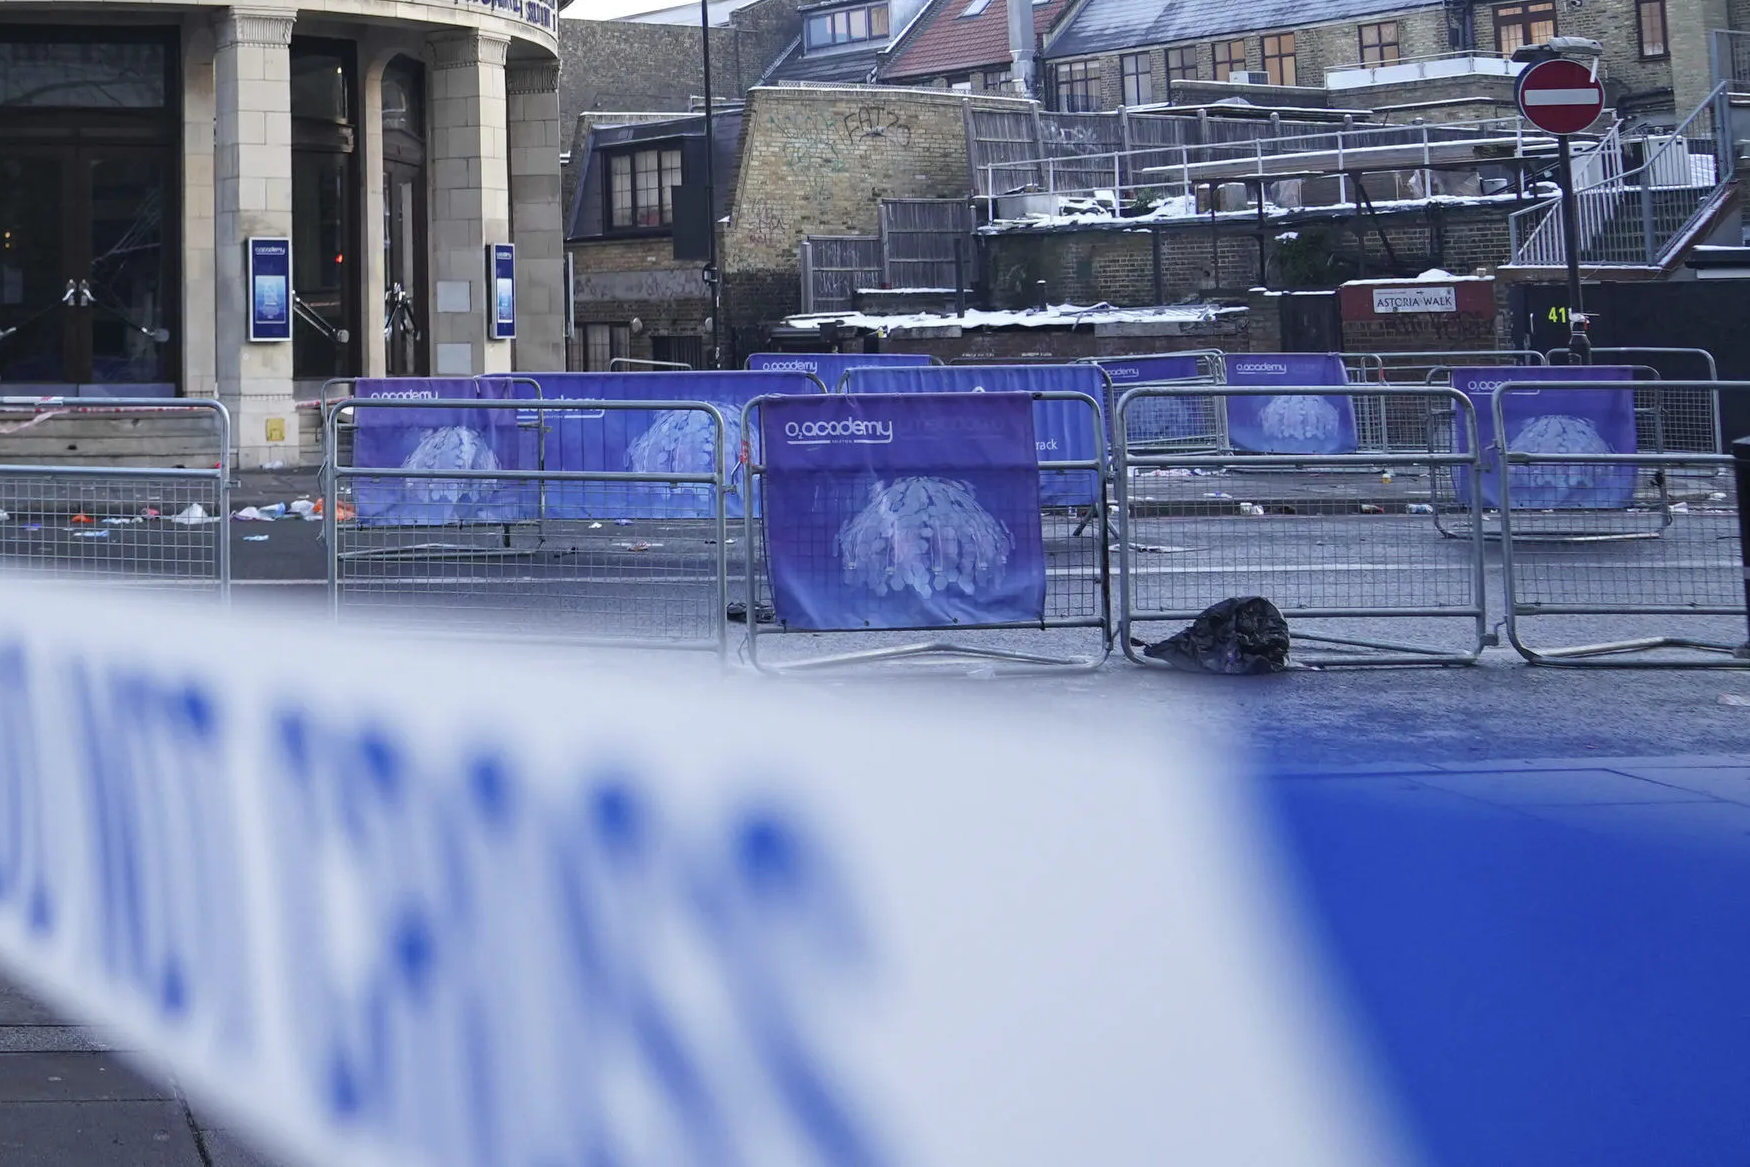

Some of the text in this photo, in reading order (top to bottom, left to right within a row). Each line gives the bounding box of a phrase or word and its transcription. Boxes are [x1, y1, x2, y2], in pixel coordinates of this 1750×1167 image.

[1377, 296, 1453, 308] ASTORIA WALK
[1547, 306, 1567, 324] 41
